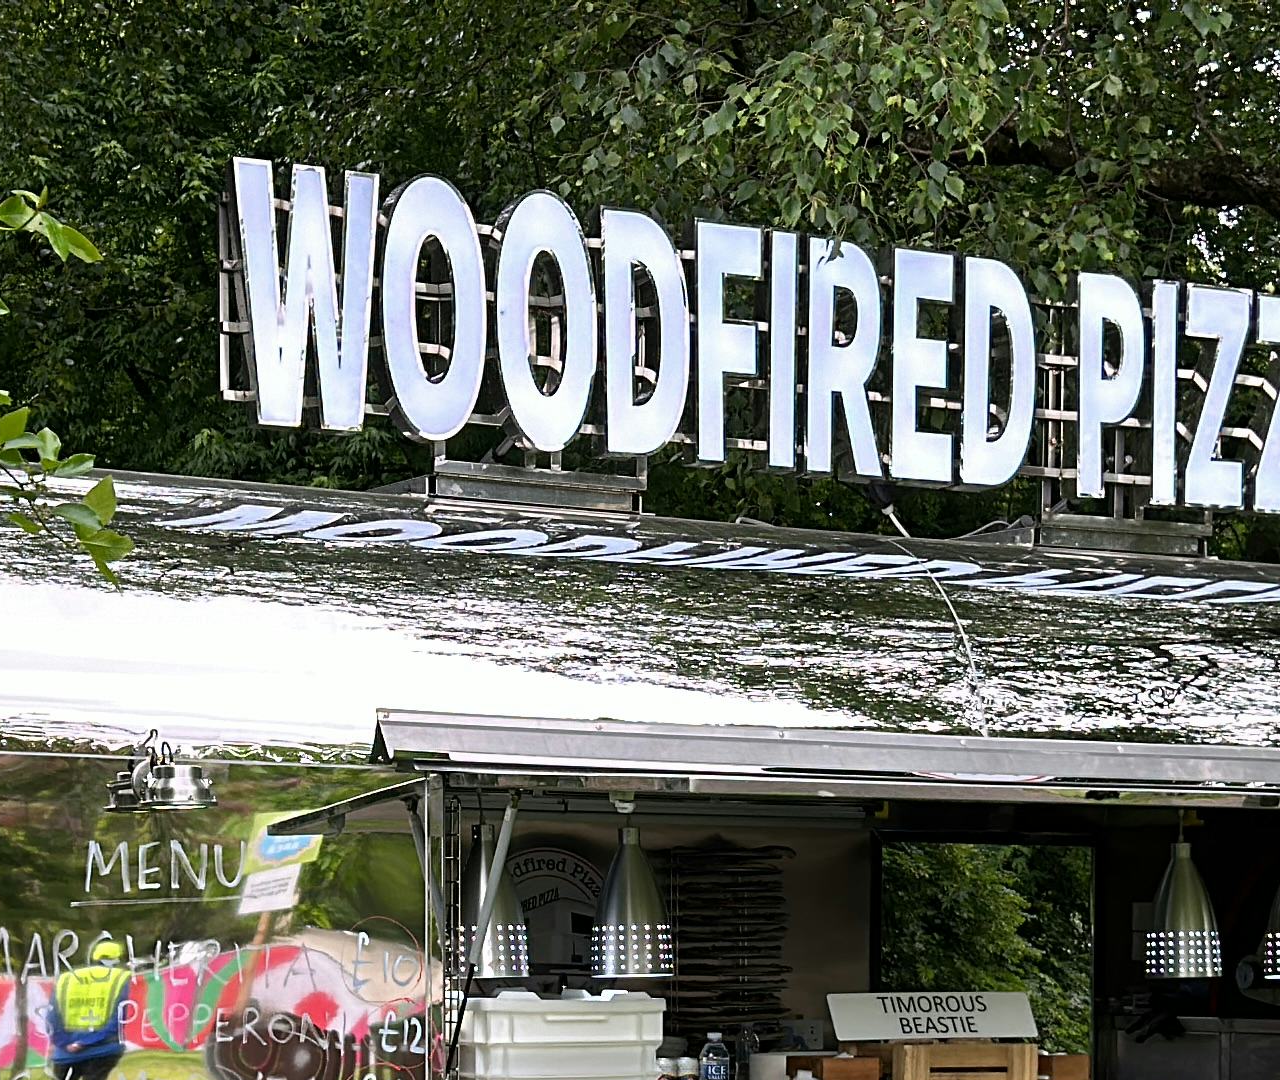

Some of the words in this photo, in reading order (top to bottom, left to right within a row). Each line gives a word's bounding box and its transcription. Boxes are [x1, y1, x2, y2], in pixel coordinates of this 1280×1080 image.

[233, 156, 1038, 491] WOODFIRED
[85, 840, 246, 894] MENU
[877, 994, 988, 1016] TIMOROUS
[117, 1000, 347, 1057] PEPPERONI
[378, 1010, 426, 1054] £12
[900, 1014, 979, 1035] BEASTIE
[707, 1065, 727, 1075] ICE
